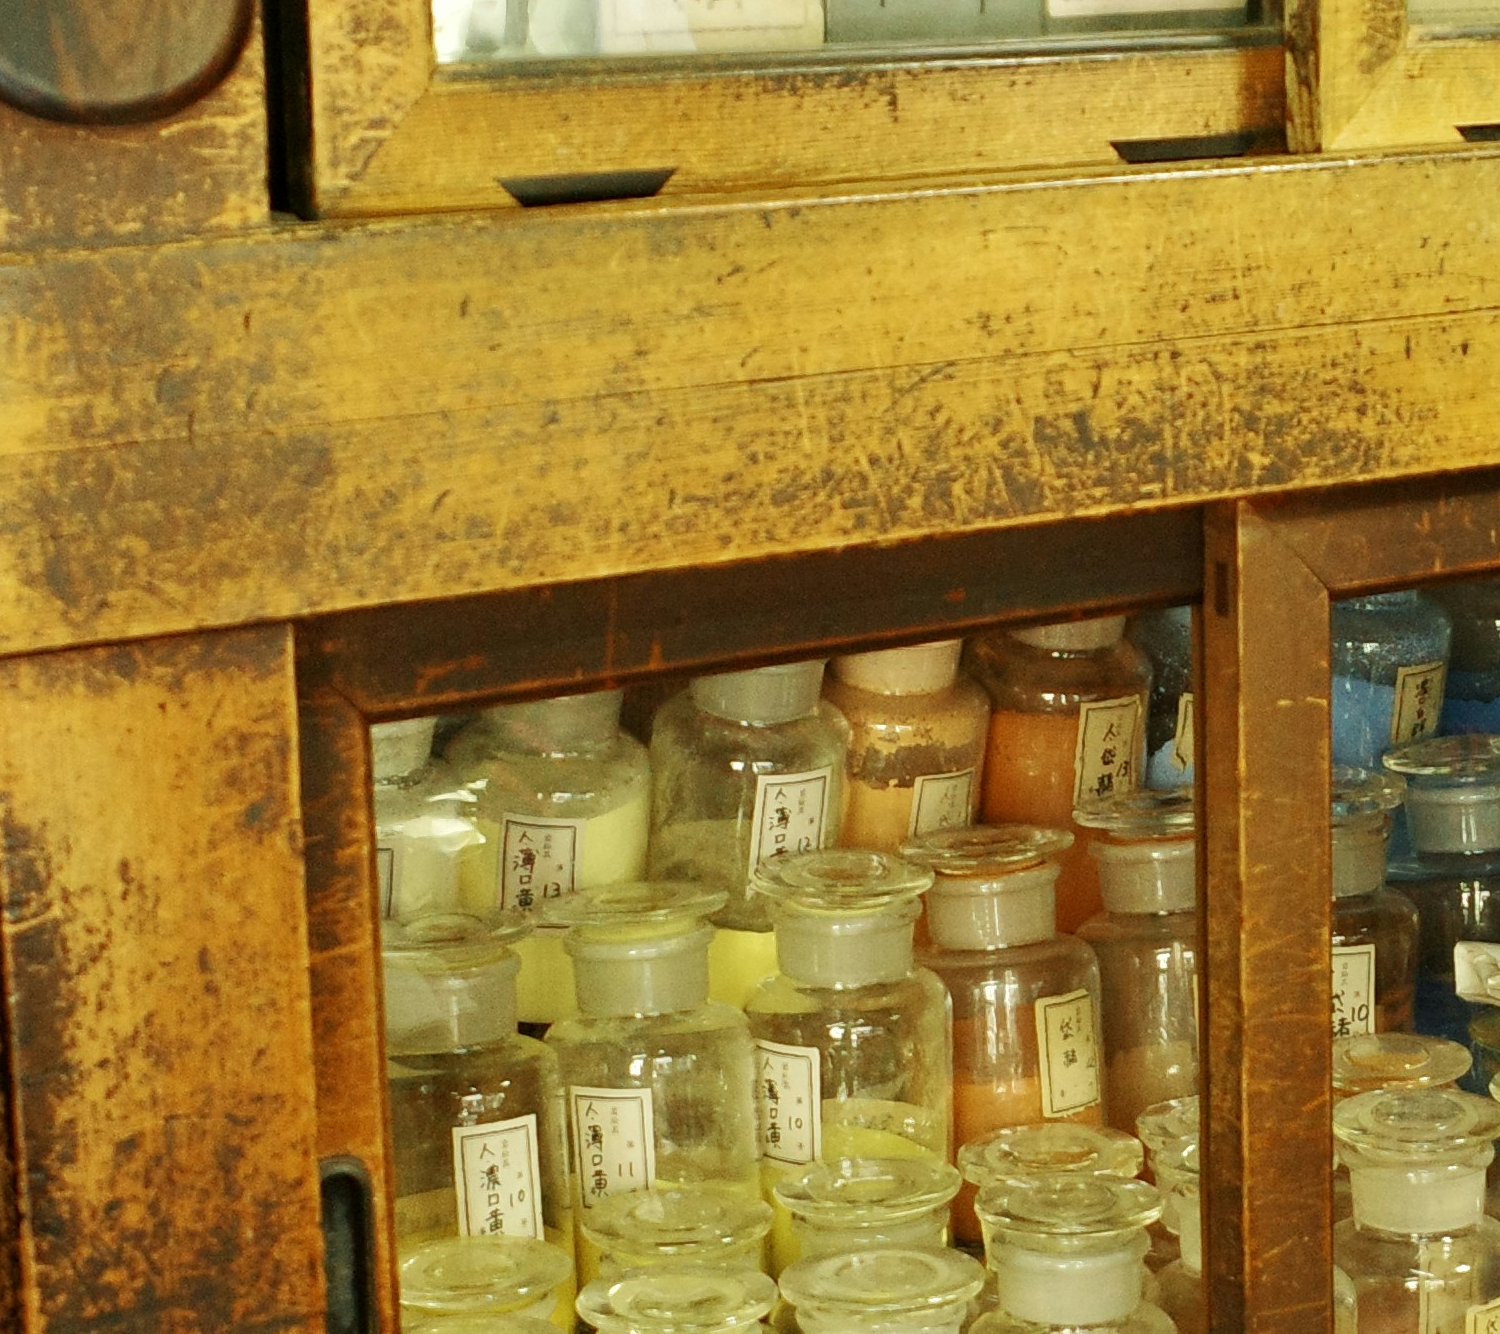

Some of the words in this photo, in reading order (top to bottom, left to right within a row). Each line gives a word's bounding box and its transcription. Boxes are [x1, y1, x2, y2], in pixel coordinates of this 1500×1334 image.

[543, 883, 561, 898] 13
[1352, 1004, 1369, 1022] 10
[788, 1116, 803, 1130] 10
[618, 1161, 634, 1178] 11
[509, 1190, 525, 1207] 10
